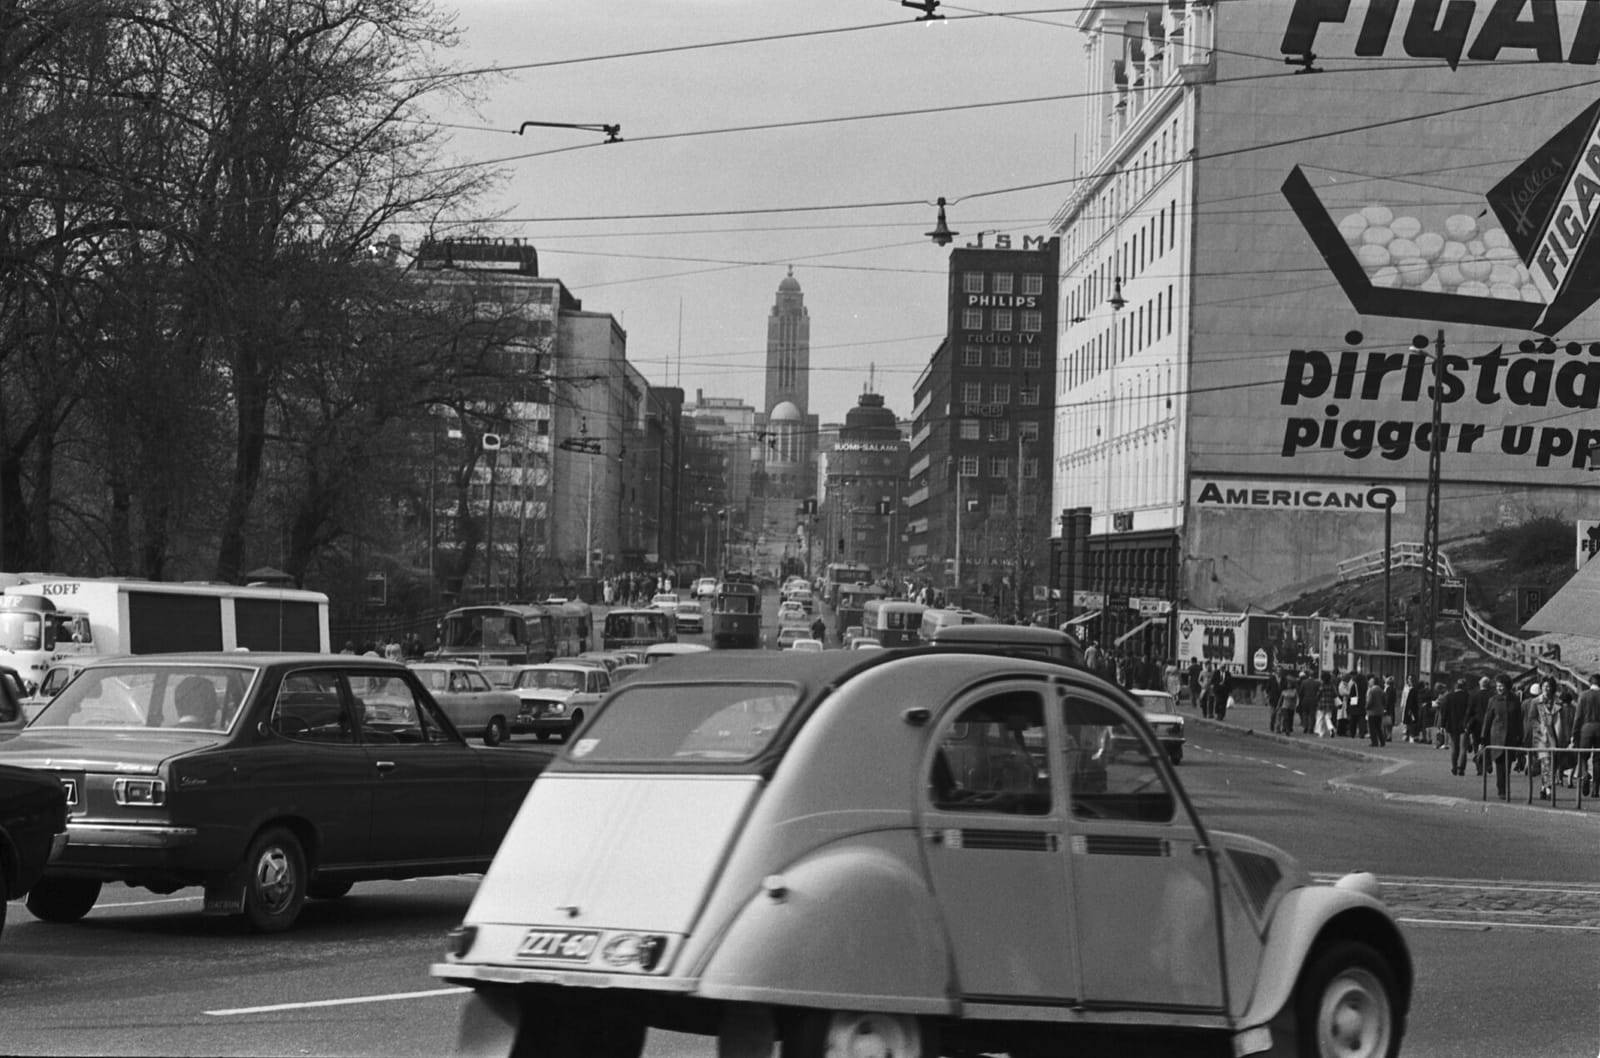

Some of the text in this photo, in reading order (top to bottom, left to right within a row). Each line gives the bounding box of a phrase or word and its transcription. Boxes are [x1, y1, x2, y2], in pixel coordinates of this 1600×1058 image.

[968, 295, 1036, 308] PHILIPS
[967, 333, 1035, 345] radio TV
[1280, 330, 1600, 408] piristää
[1281, 404, 1600, 469] piggar upp
[1197, 483, 1397, 509] AMERICANO
[42, 583, 81, 595] KOFF
